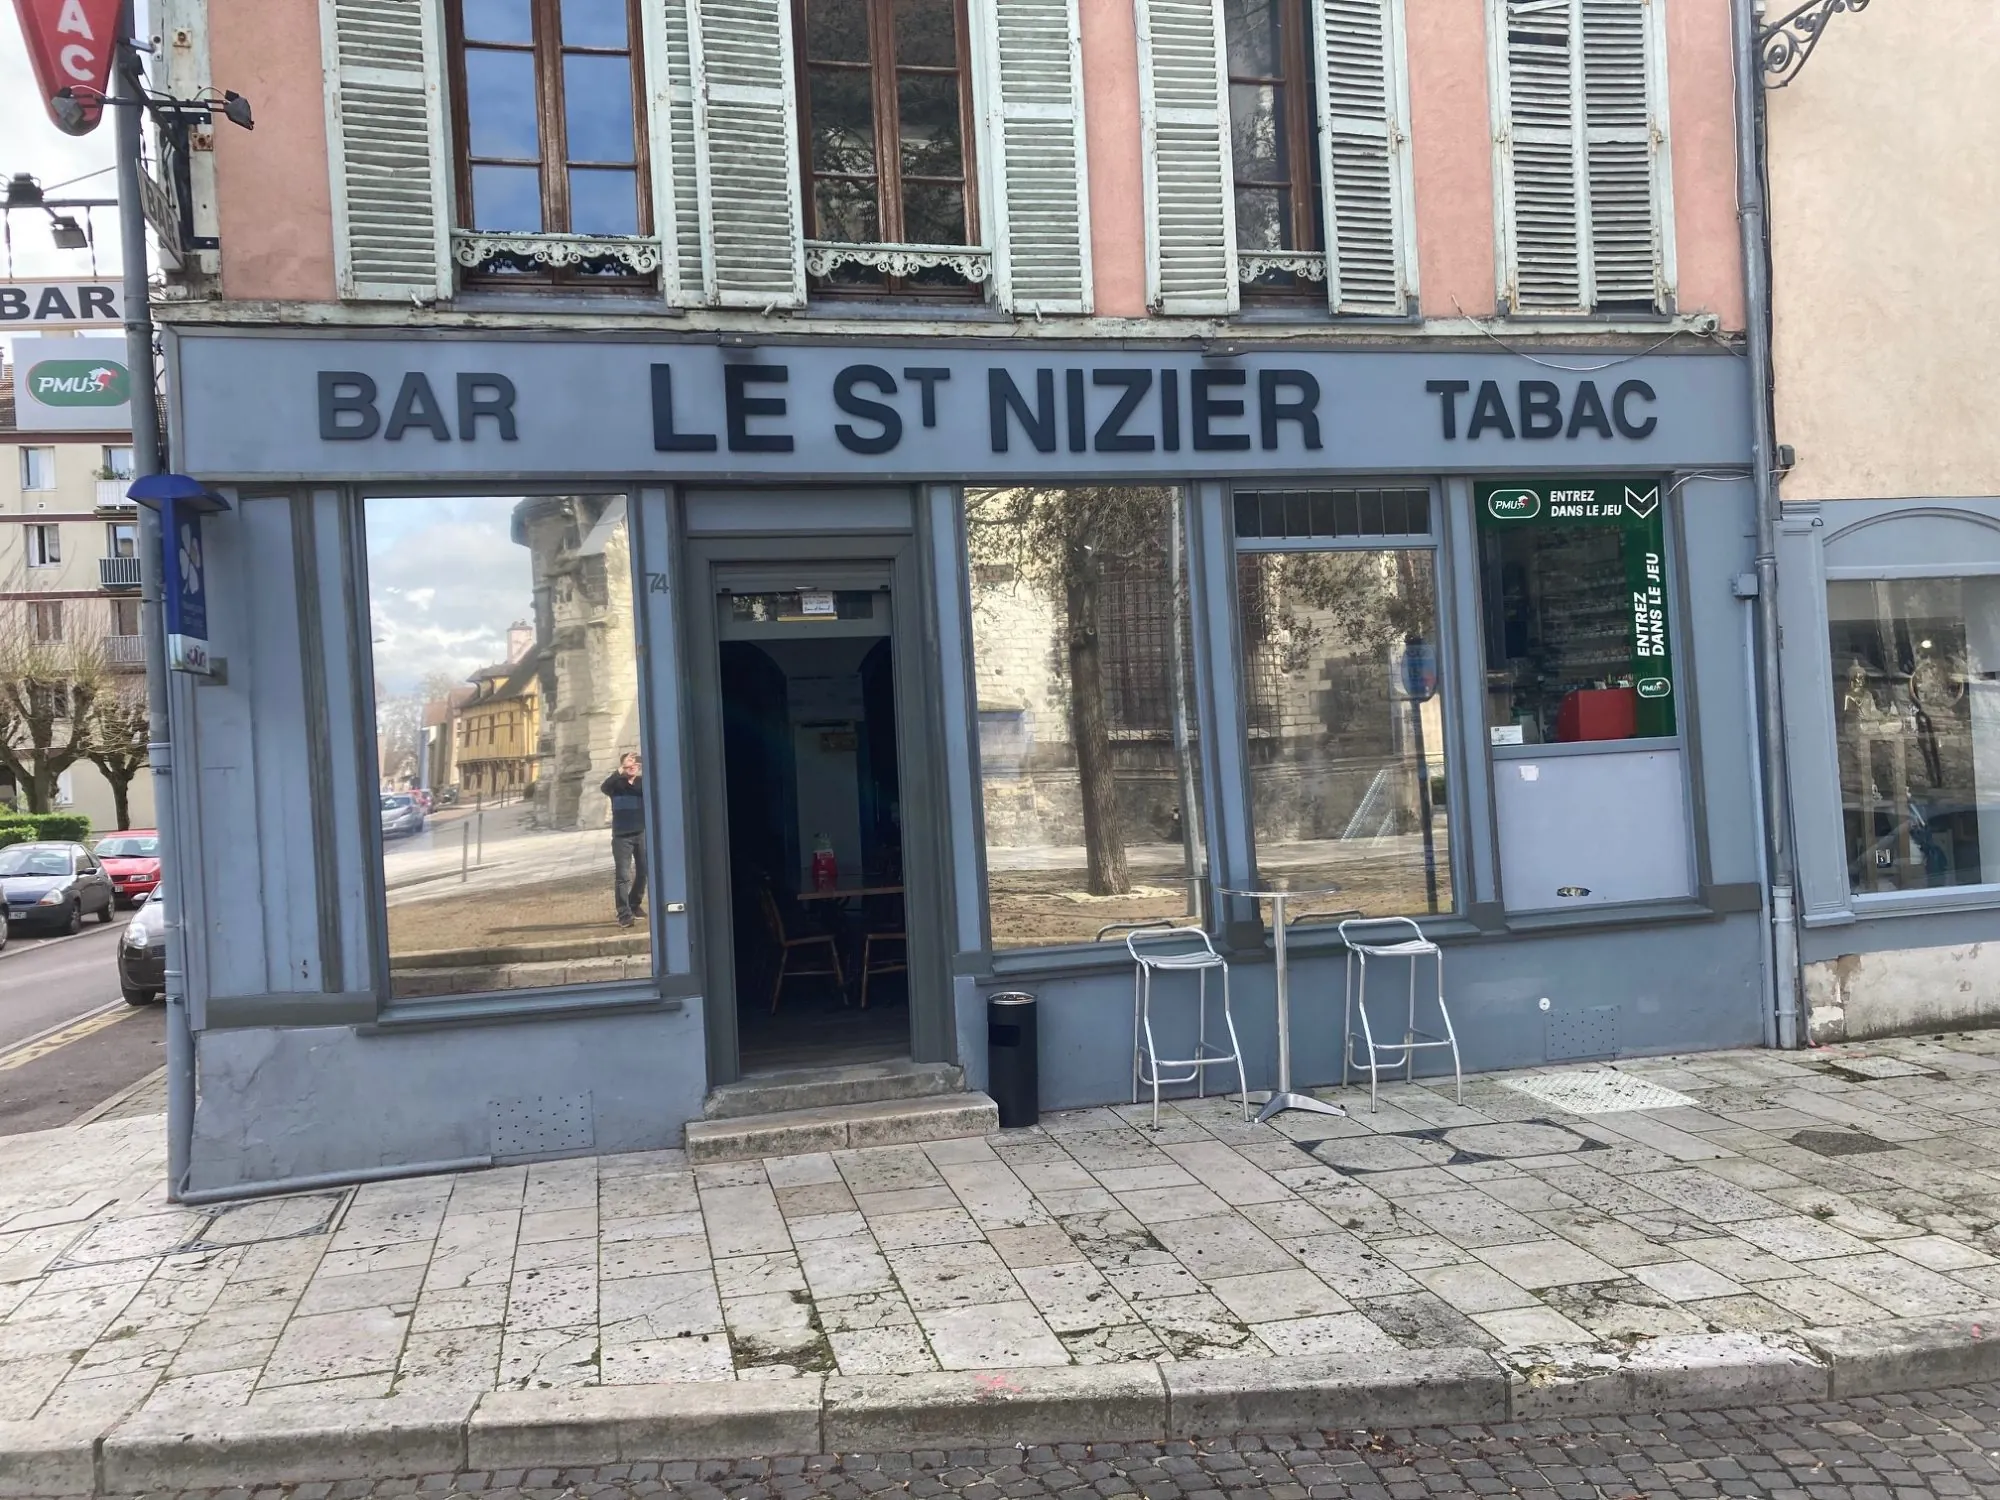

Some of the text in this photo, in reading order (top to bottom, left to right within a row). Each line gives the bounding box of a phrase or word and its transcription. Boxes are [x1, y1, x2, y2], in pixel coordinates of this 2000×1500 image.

[144, 180, 178, 250] BAR
[0, 286, 121, 320] BAR
[37, 377, 88, 393] PMU
[317, 370, 519, 442] BAR
[649, 362, 796, 453] LE
[988, 367, 1324, 453] NIZIER
[1426, 379, 1659, 440] TABAC
[1495, 500, 1517, 510] PMU
[1550, 490, 1595, 502] ENTREZ
[1551, 504, 1622, 517] DANS LE JEU
[644, 572, 670, 594] 74
[1646, 553, 1665, 656] DANS LE JEU
[1634, 592, 1650, 656] ENTREZ
